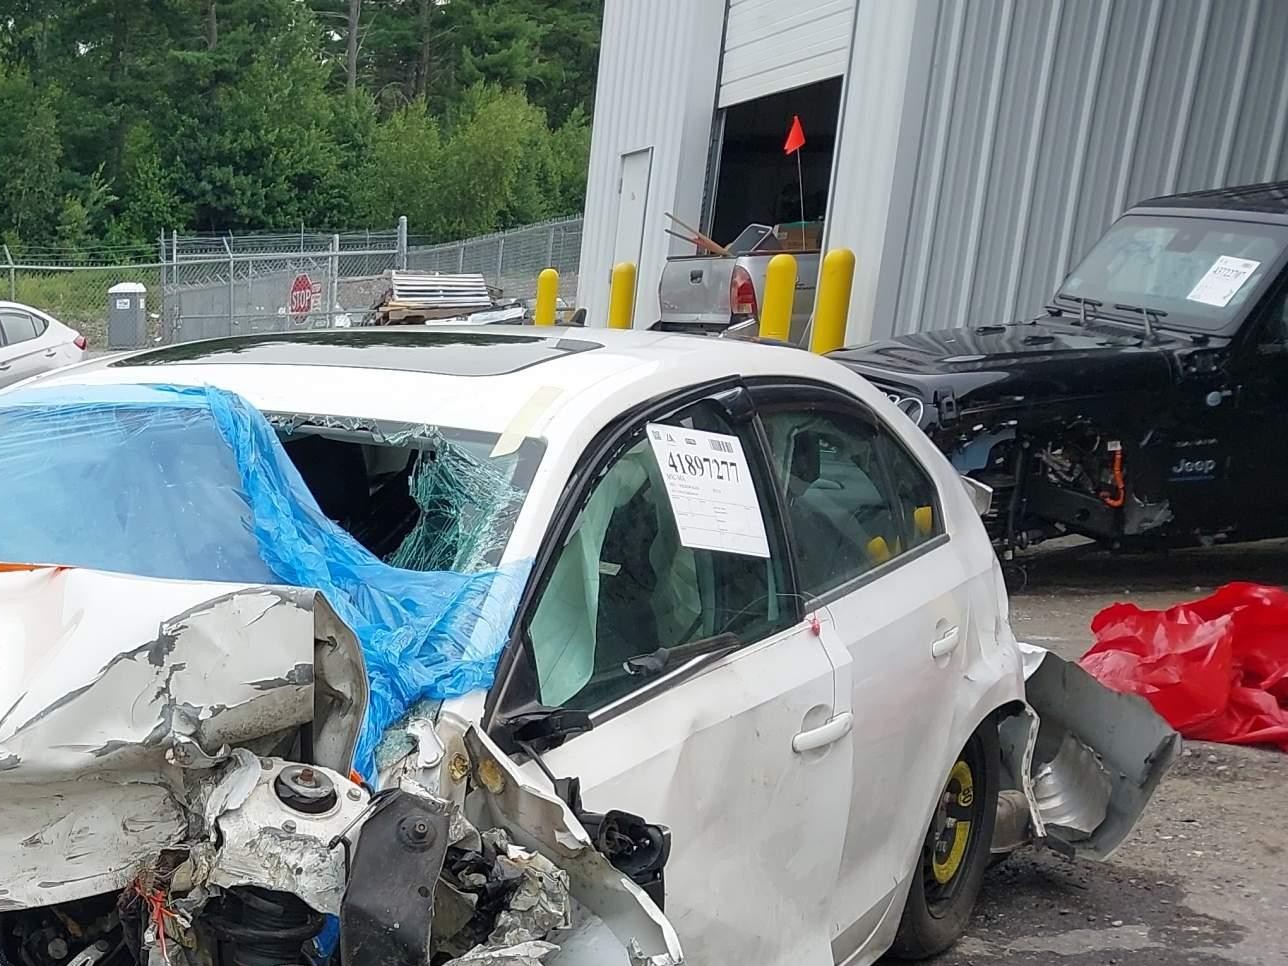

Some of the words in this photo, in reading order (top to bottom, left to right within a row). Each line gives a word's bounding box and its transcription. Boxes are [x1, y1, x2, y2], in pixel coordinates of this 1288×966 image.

[292, 289, 312, 309] STOP
[668, 450, 740, 482] 41897277
[1172, 458, 1217, 474] Jeep
